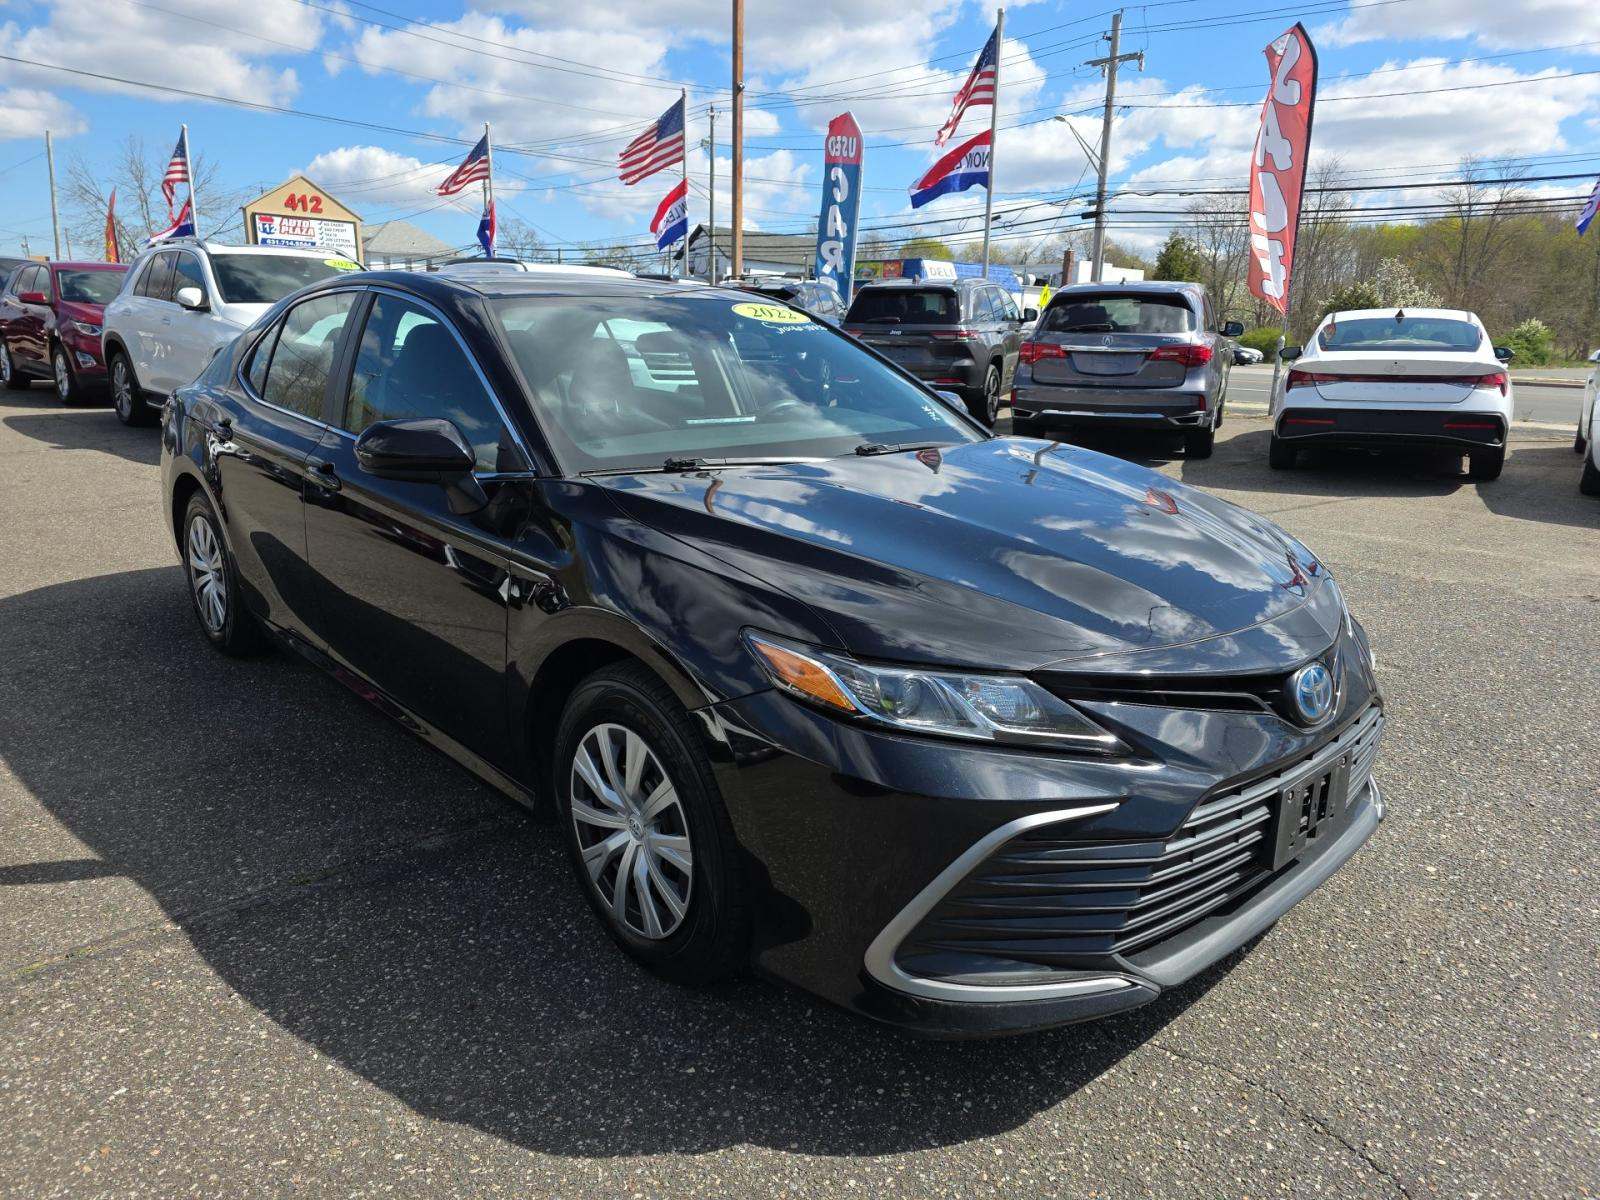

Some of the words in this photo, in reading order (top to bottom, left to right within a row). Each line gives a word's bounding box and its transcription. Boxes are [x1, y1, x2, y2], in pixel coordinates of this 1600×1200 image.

[284, 192, 324, 214] 412
[258, 222, 277, 235] 112
[280, 217, 312, 228] AUTO
[279, 225, 316, 237] PLAZA
[929, 266, 954, 278] DELI
[747, 305, 798, 320] 2022
